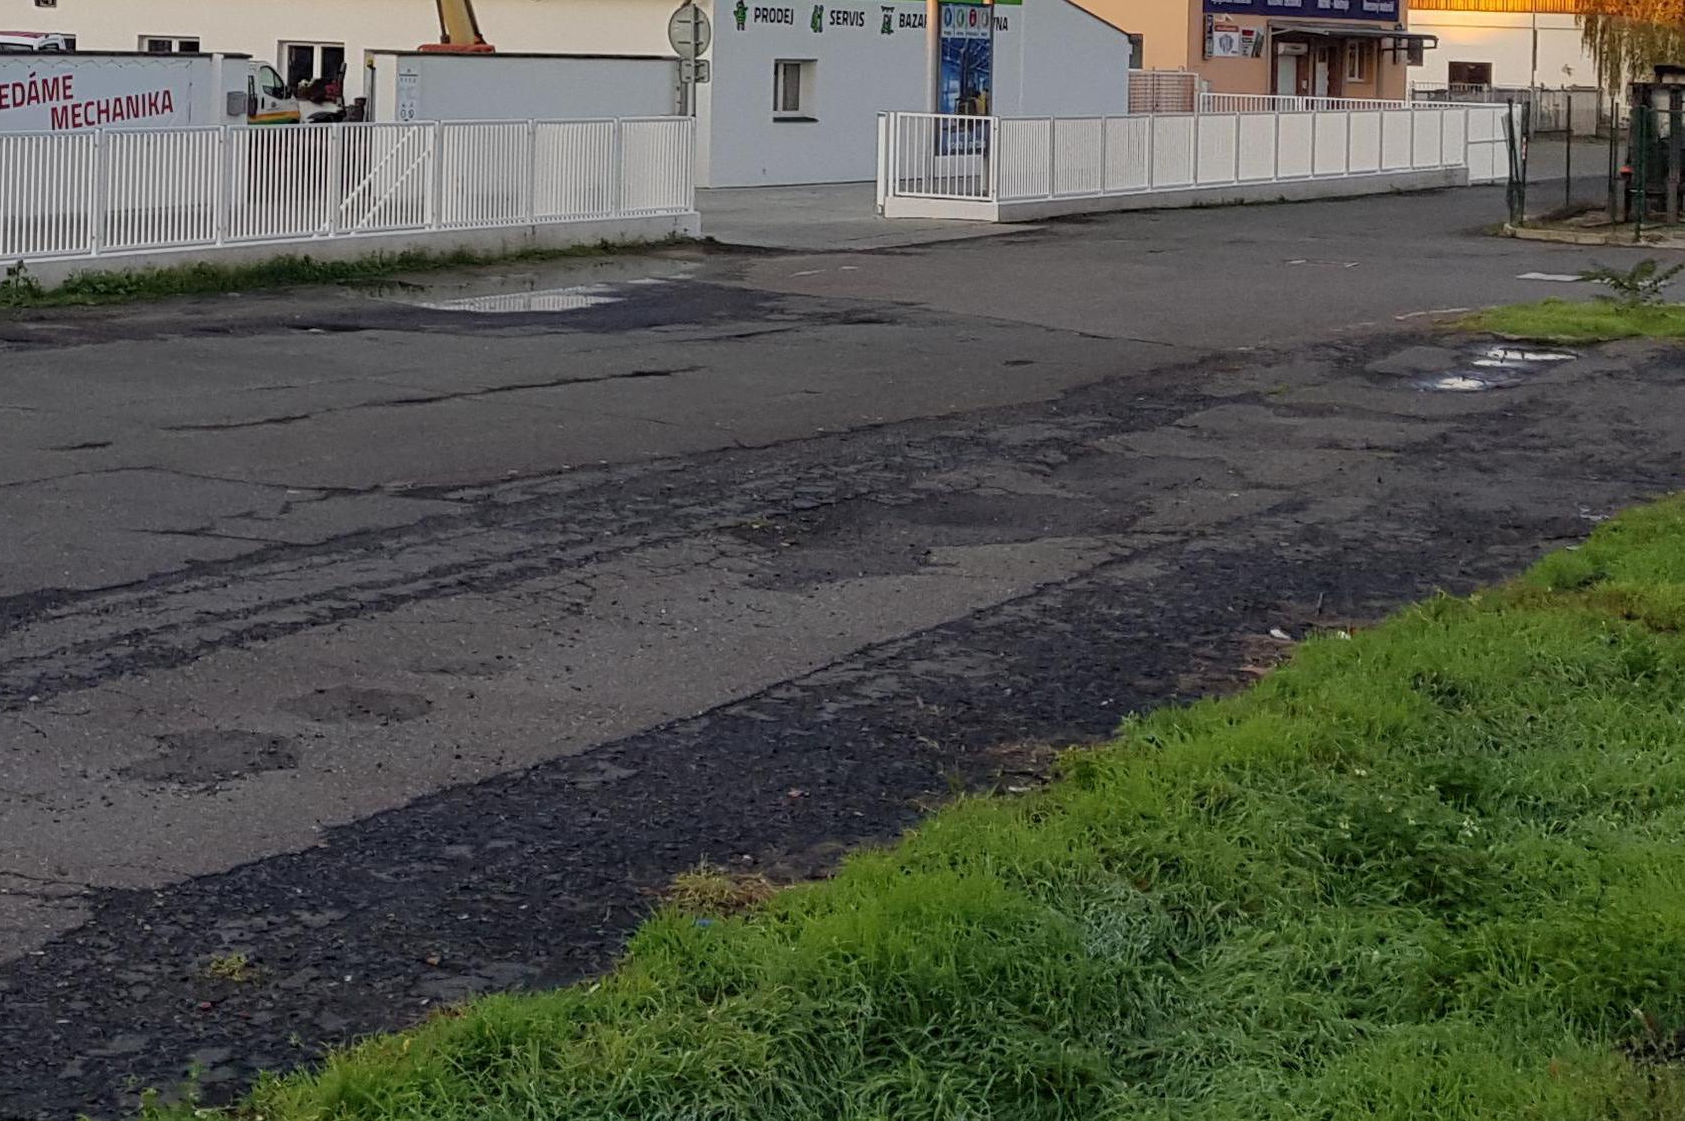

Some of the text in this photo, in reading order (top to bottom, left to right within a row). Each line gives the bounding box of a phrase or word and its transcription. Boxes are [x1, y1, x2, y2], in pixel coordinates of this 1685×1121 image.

[754, 7, 794, 25] PRODEJ
[829, 9, 865, 27] SERVIS
[51, 89, 174, 130] MECHANIKA
